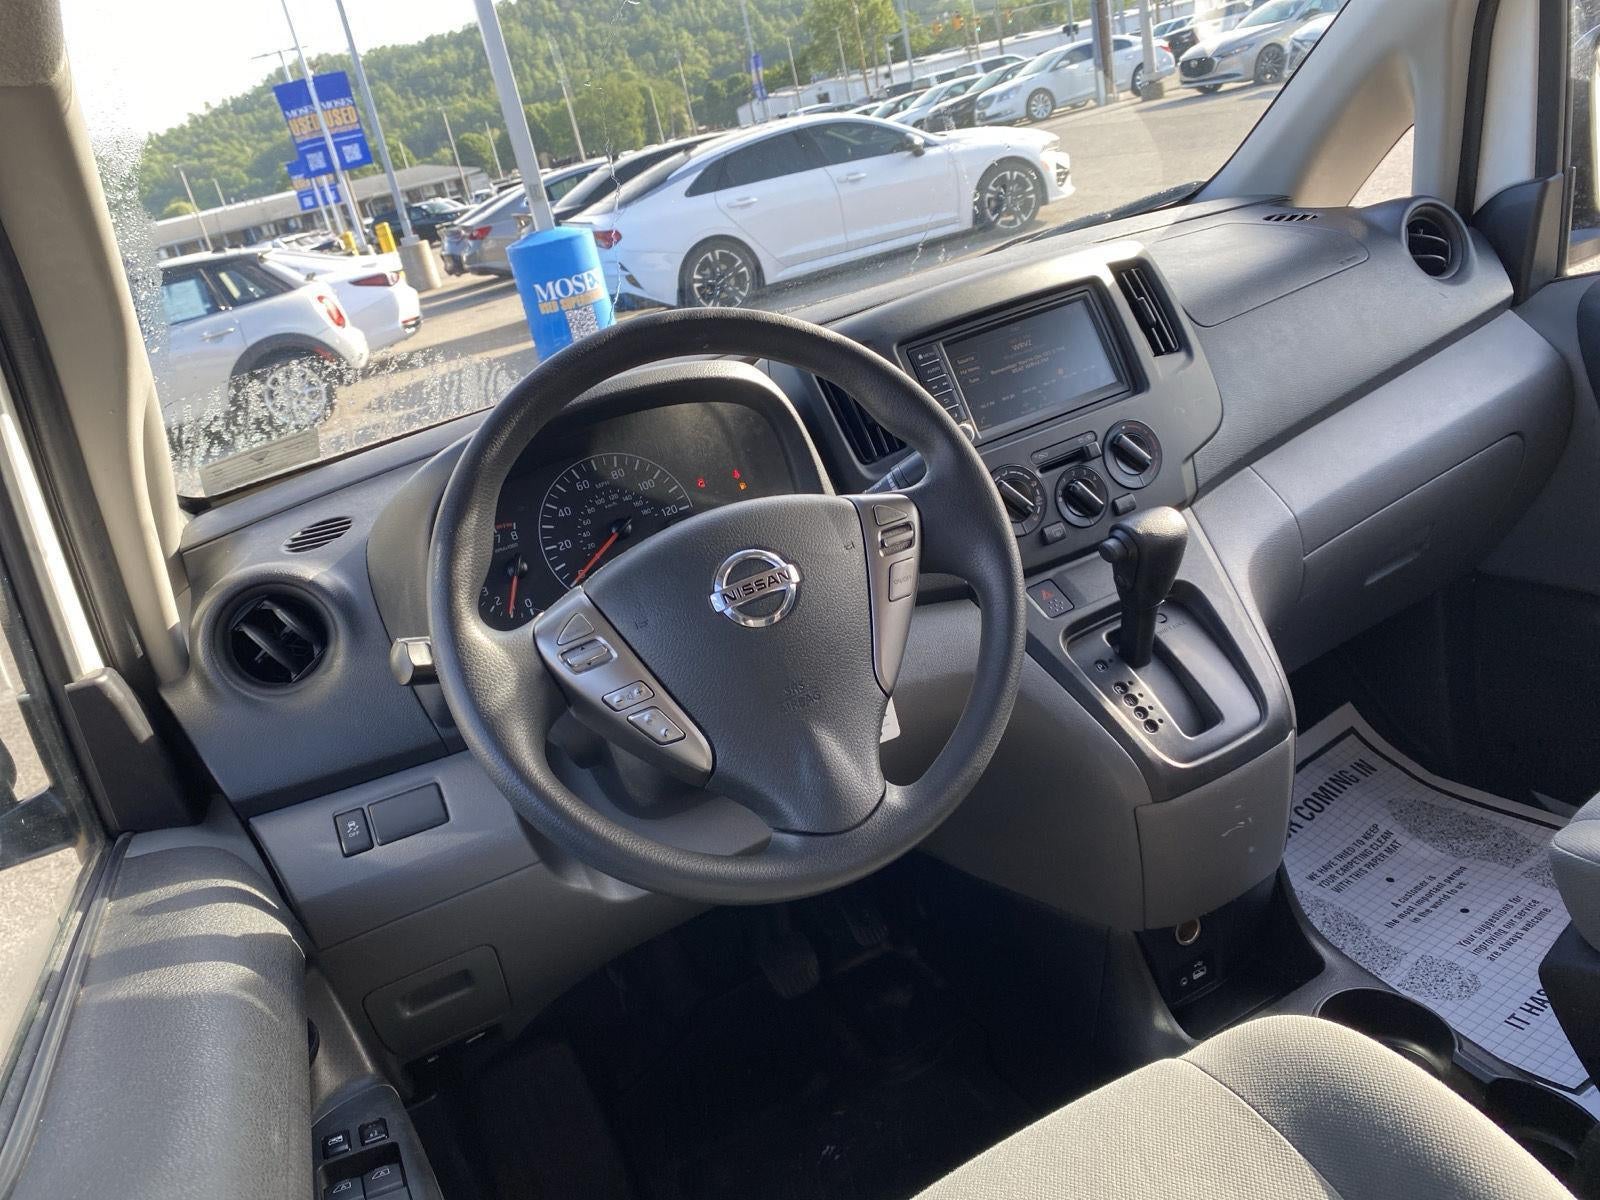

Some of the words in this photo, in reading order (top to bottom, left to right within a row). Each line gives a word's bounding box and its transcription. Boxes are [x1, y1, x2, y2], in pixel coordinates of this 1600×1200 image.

[323, 105, 358, 127] USED
[533, 268, 601, 303] MOSE
[611, 468, 625, 480] 80
[638, 479, 655, 491] 100
[576, 480, 590, 491] 60
[558, 506, 572, 518] 40
[661, 504, 678, 517] 120
[510, 530, 519, 541] 8
[559, 540, 572, 551] 20
[482, 587, 489, 597] 3
[722, 569, 791, 604] NISSAN
[494, 596, 502, 606] 2
[524, 598, 533, 608] 0
[1293, 770, 1360, 821] COMING
[1350, 758, 1378, 777] IN
[1305, 871, 1320, 881] WE
[1316, 860, 1338, 875] HAVE
[1334, 846, 1355, 862] TRIED
[1352, 839, 1365, 849] TO
[1361, 823, 1379, 841] KEEP
[1317, 874, 1337, 888] YOUR
[1335, 848, 1373, 876] CARPETING
[1370, 829, 1394, 851] CLEAN
[1331, 878, 1353, 893] WITH
[1349, 867, 1369, 880] THIS
[1364, 852, 1389, 870] PAPER
[1384, 839, 1402, 855] MAT
[1384, 918, 1400, 928] the
[1397, 905, 1416, 919] most
[1411, 882, 1446, 906] important
[1443, 866, 1468, 884] person
[1398, 880, 1428, 903] customer
[1417, 908, 1433, 917] the
[1429, 893, 1451, 909] world
[1456, 934, 1477, 947] Your
[1474, 903, 1514, 935] suggestions
[1508, 895, 1523, 905] for
[1471, 928, 1508, 956] improving
[1502, 918, 1517, 929] our
[1514, 899, 1540, 920] service
[1486, 951, 1502, 962] are
[1498, 931, 1524, 952] always
[1504, 1012, 1531, 1031] IT
